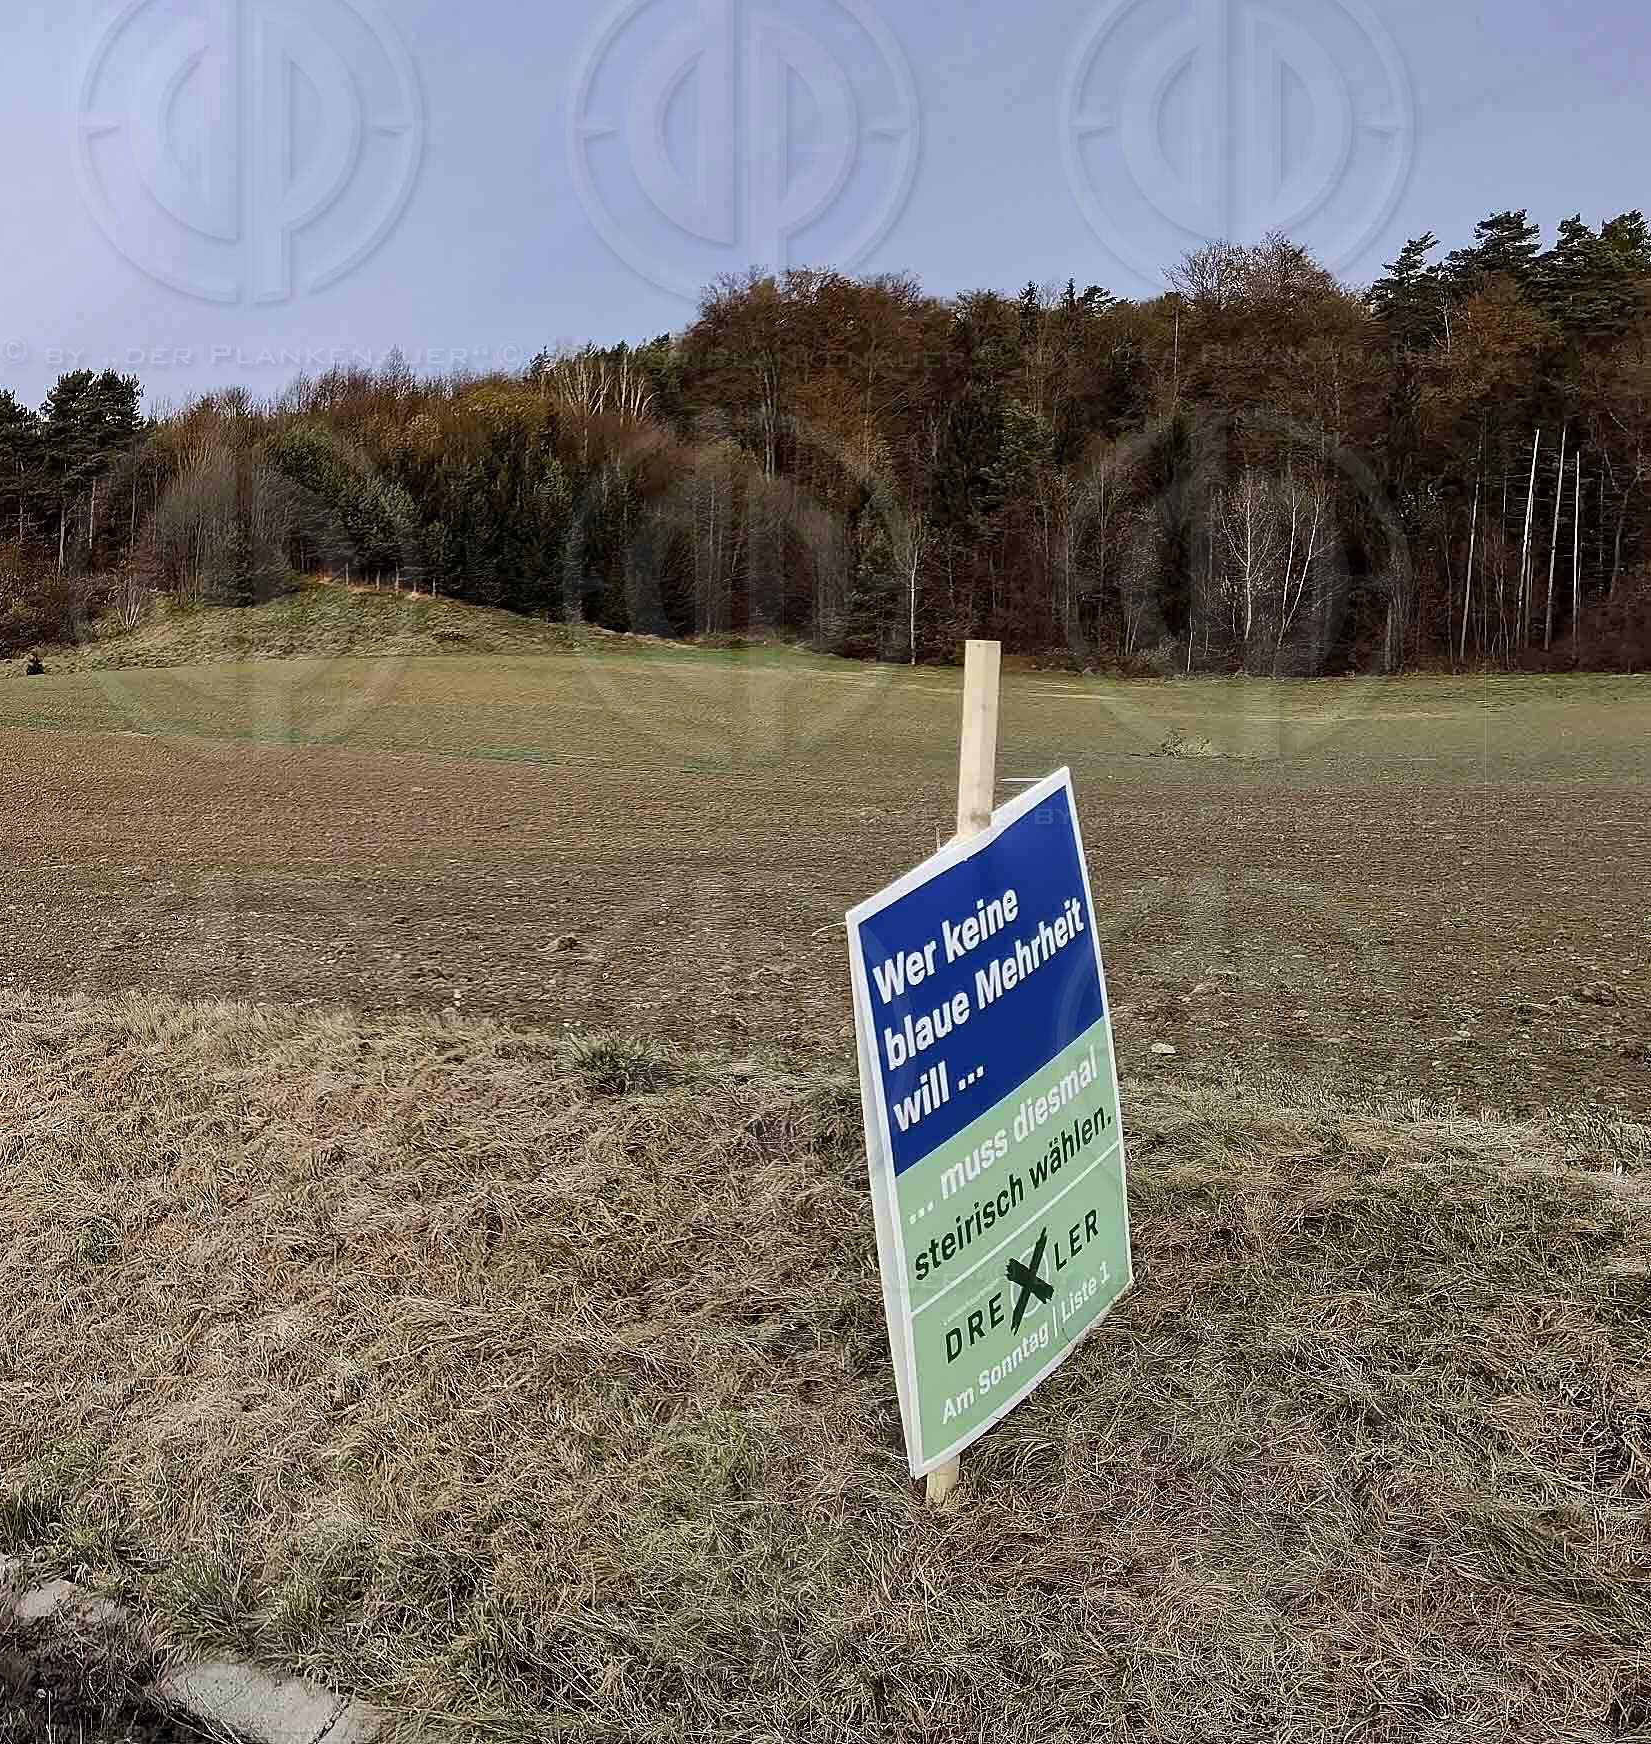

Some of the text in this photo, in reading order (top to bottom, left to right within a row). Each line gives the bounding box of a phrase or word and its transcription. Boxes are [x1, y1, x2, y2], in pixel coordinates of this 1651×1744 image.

[872, 888, 1019, 1005] Wer keine
[884, 897, 1085, 1071] blaue Mehrheit
[893, 1060, 950, 1132] will
[940, 1129, 1008, 1196] muss
[1013, 1046, 1098, 1143] diesmal
[914, 1105, 1113, 1281] steirisch wählen.
[941, 1384, 975, 1425] Am
[978, 1326, 1049, 1397] Sonntag
[1060, 1278, 1098, 1325] Liste
[1098, 1261, 1112, 1286] 1
[945, 1208, 1099, 1364] DREXLER
